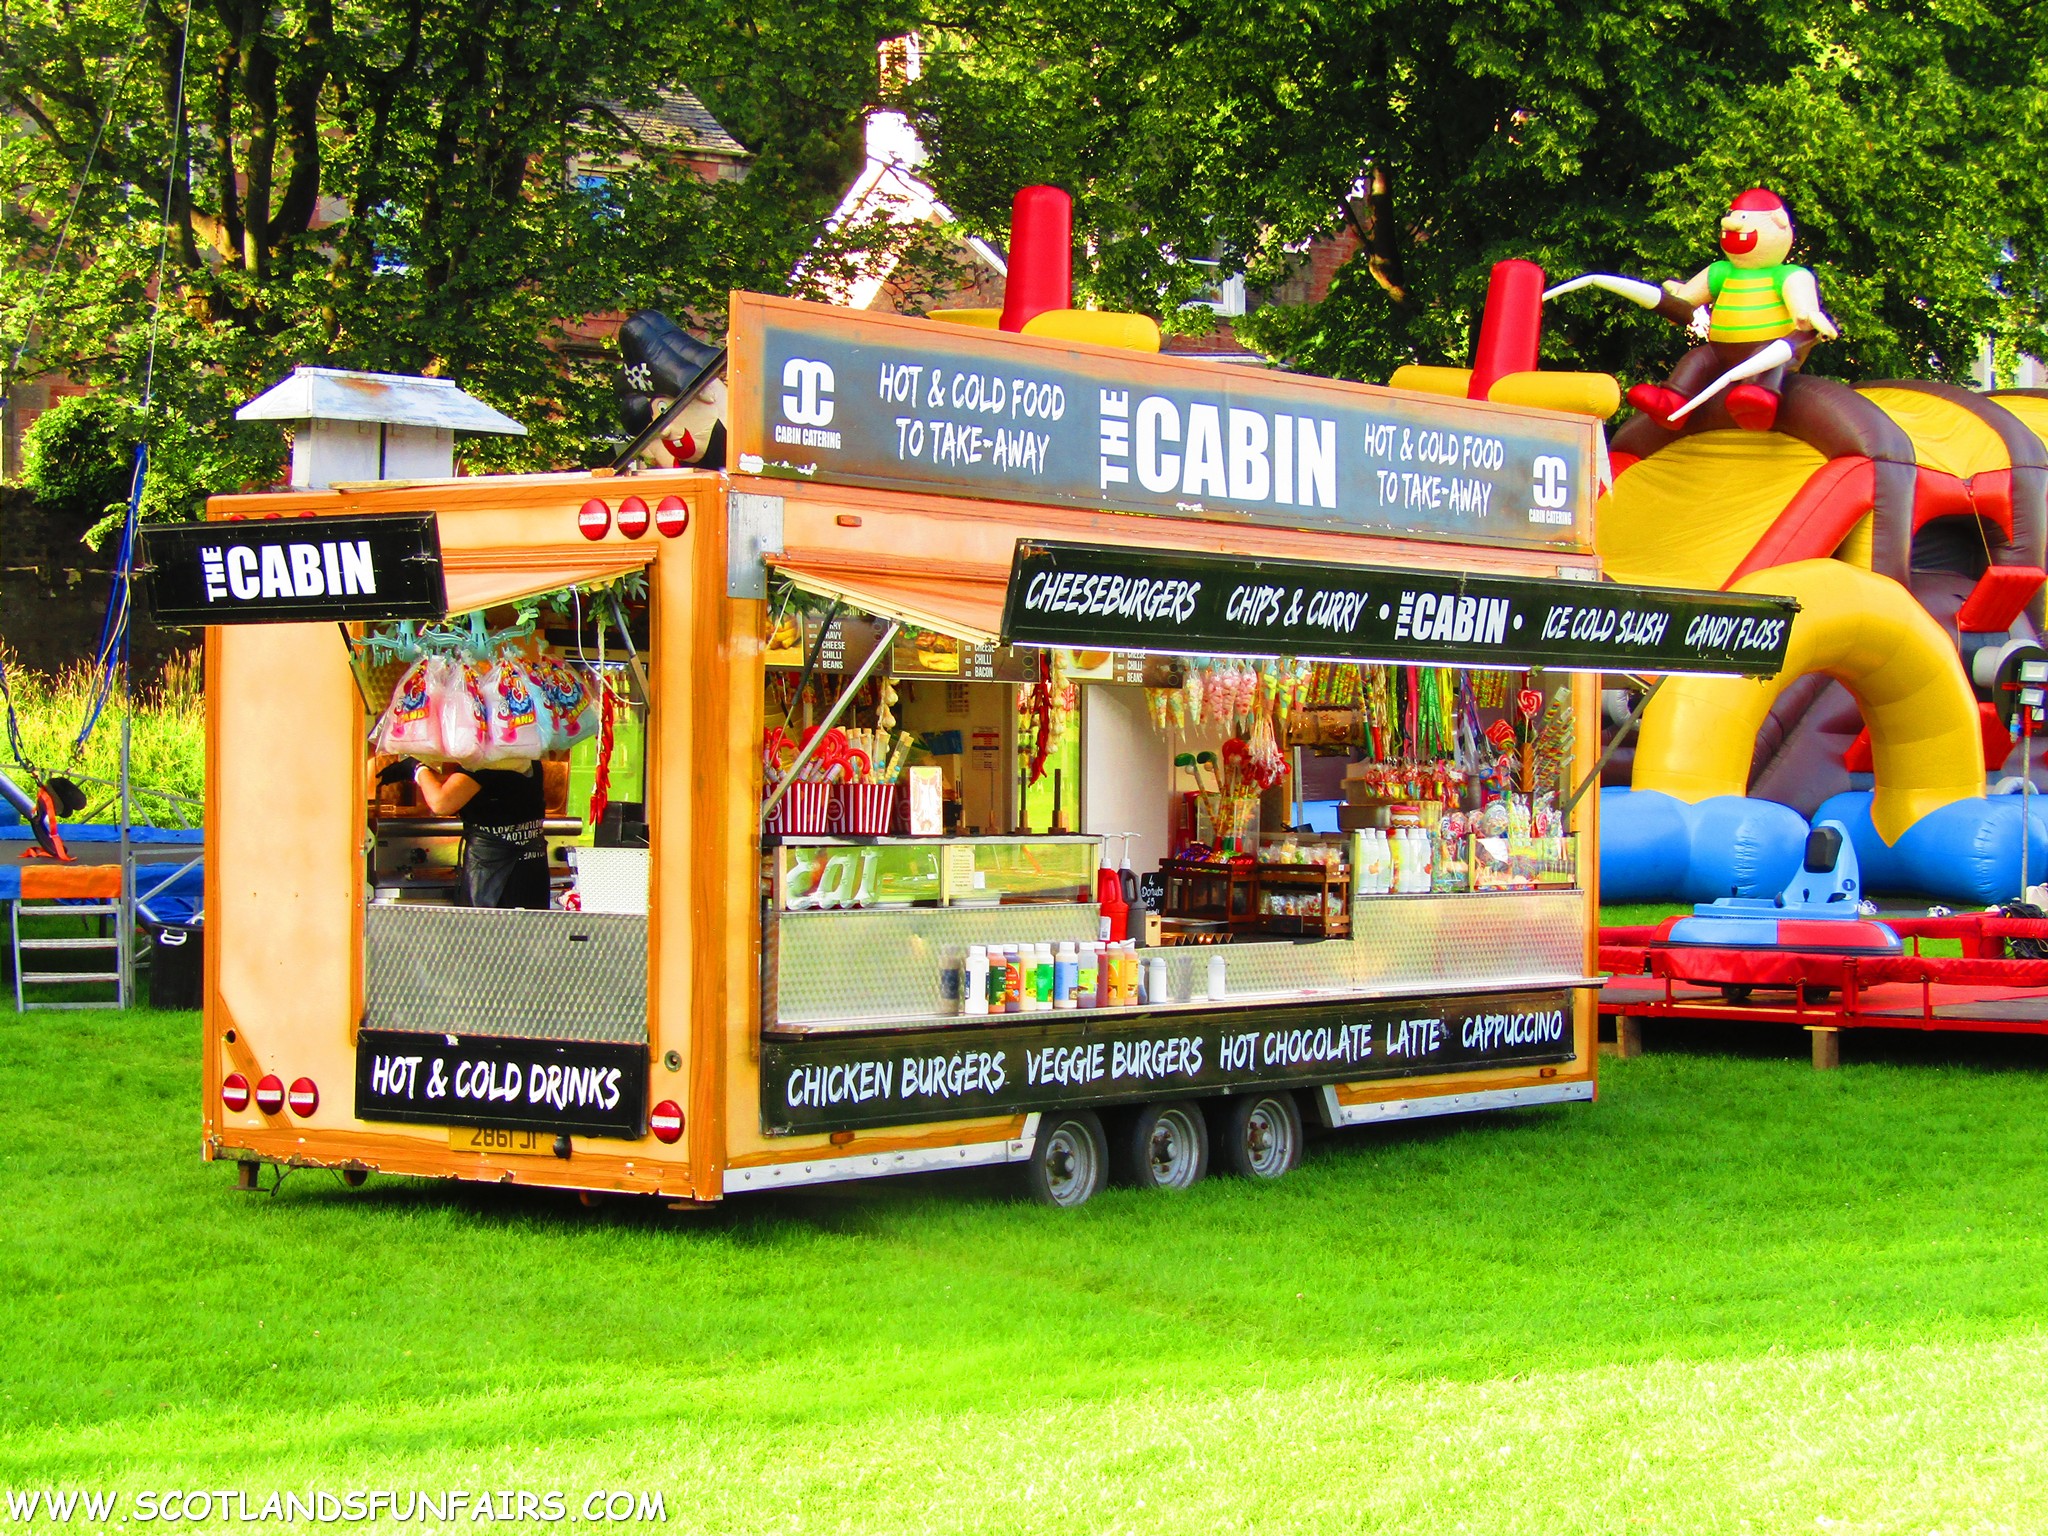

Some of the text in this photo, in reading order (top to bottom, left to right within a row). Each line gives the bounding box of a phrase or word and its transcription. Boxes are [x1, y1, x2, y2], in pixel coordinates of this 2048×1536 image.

[880, 363, 1066, 421] HOT & COLD FOOD
[775, 425, 841, 450] CABIN CATERING
[896, 418, 1050, 476] TO TAKE-AWAY
[1100, 388, 1337, 509] THE CABIN
[1364, 423, 1504, 471] HOT & COLD FOOD
[1377, 470, 1492, 518] TO TAKE-AWAY
[1529, 508, 1572, 525] CABIN CATERING
[202, 540, 377, 602] THE CABIN
[1025, 572, 1201, 624] CHEESEBURGERS
[1226, 585, 1369, 633] CHIPS & CURRY
[1394, 591, 1509, 644] THE CABIN
[822, 640, 846, 650] CHEESE
[1541, 606, 1669, 647] ICE COLD SLUSH
[1685, 614, 1785, 651] CANDY FLOSS
[822, 651, 842, 659] CHILLI
[822, 660, 844, 669] BEANS
[974, 653, 992, 665] CHILLI
[974, 666, 993, 678] BACON
[1141, 886, 1164, 898] Donuts
[1148, 875, 1155, 886] 4
[1220, 1022, 1372, 1072] HOT CHOCOLATE
[1386, 1018, 1440, 1058] LATTE
[1461, 1010, 1563, 1052] CAPPUCCINO
[787, 1051, 1006, 1108] CHICKEN BURGERS
[1026, 1036, 1203, 1087] VEGGIE BURGERS
[372, 1055, 622, 1111] HOT & COLD DRINKS
[470, 1128, 514, 1148] 2861
